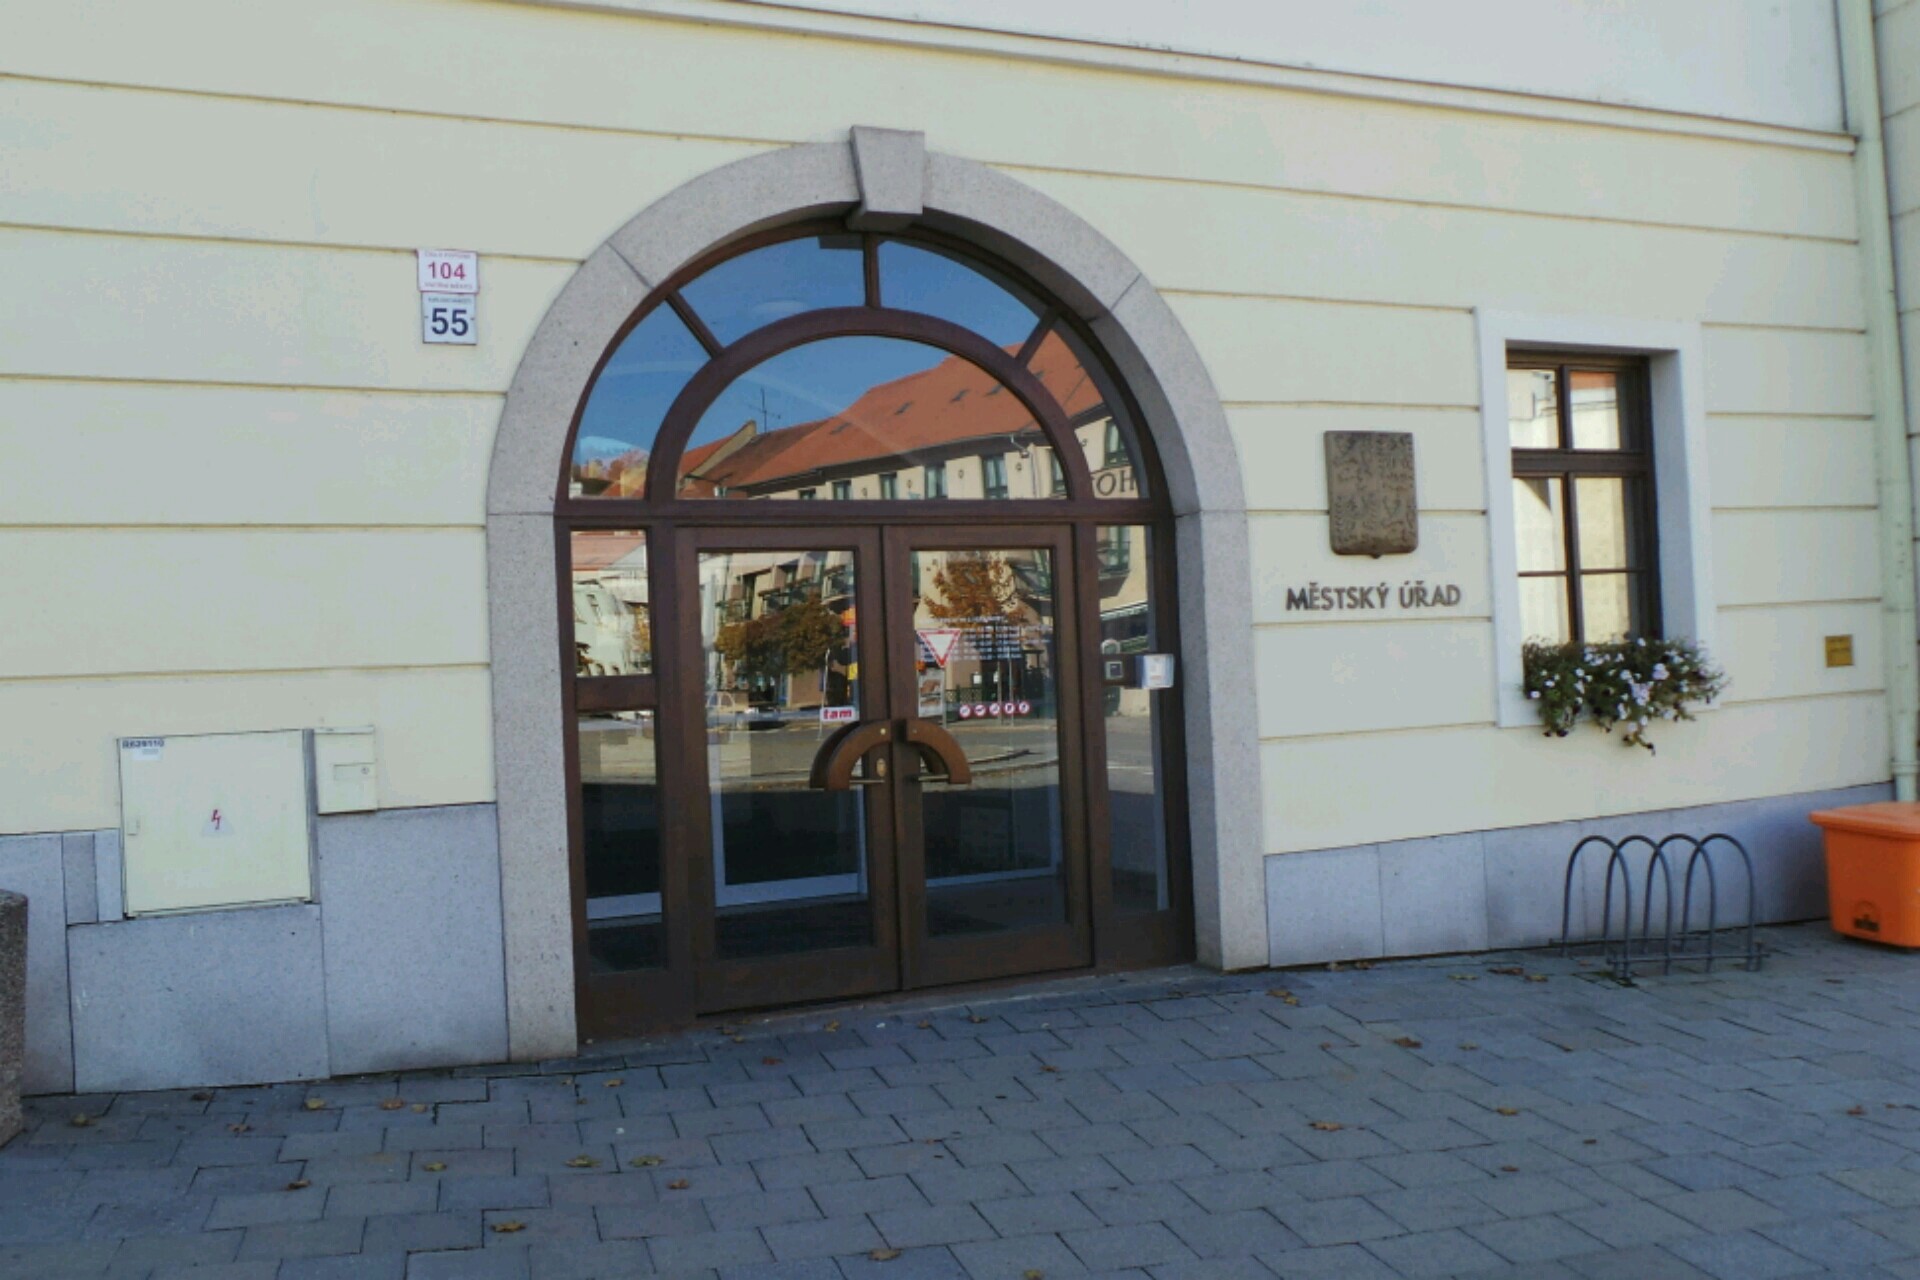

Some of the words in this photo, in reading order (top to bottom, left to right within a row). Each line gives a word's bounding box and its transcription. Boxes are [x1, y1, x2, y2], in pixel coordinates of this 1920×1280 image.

[427, 261, 466, 280] 104
[431, 307, 469, 336] 55
[1286, 582, 1390, 611] MĚSTSKÝ
[1400, 580, 1462, 609] ÚŘAD
[823, 709, 853, 720] tam
